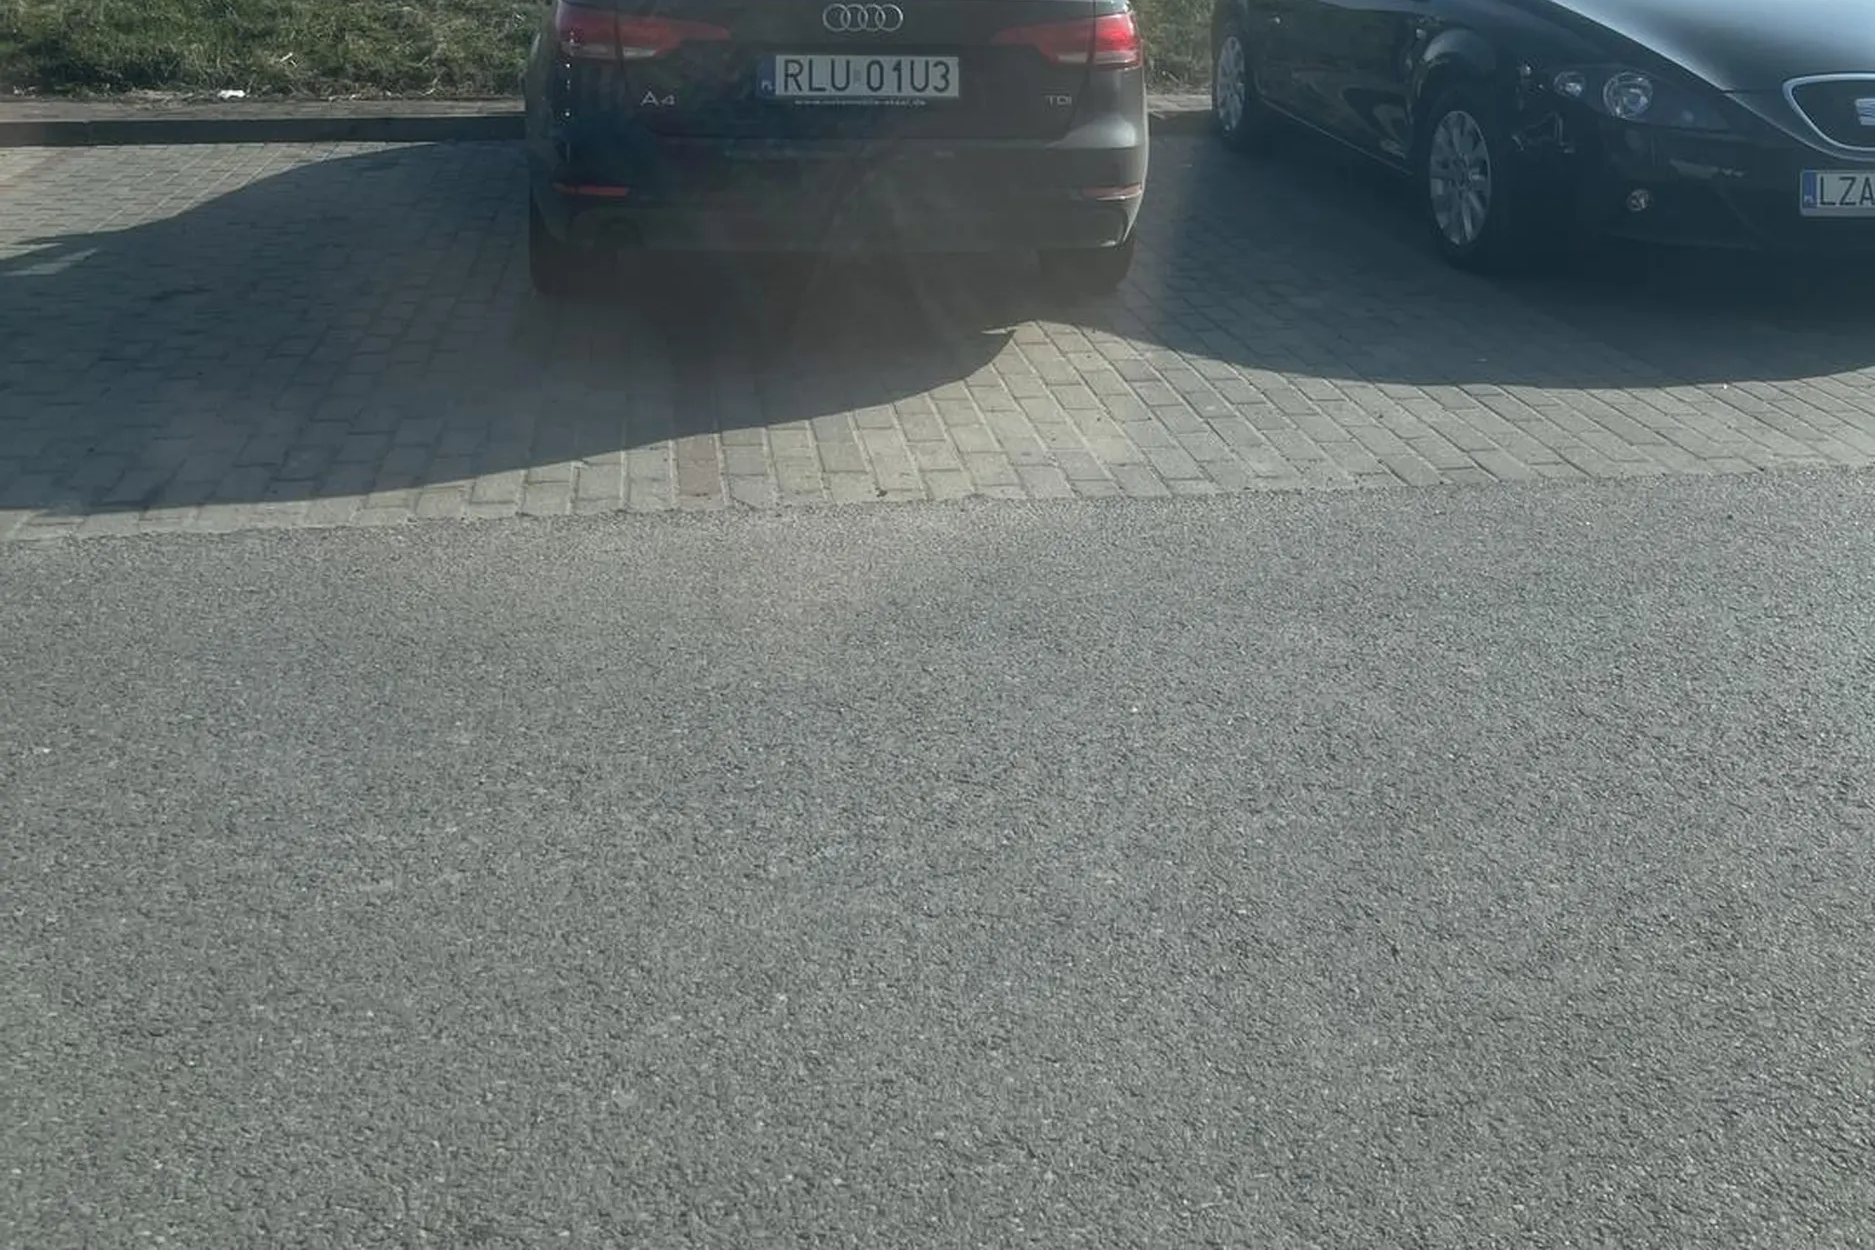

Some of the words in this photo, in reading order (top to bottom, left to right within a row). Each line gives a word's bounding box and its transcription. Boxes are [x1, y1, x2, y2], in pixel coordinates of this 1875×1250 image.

[783, 58, 850, 92] RLU
[866, 59, 950, 93] 01U3
[640, 91, 676, 107] A4
[1044, 94, 1072, 107] TDI
[1820, 175, 1875, 206] LZA
